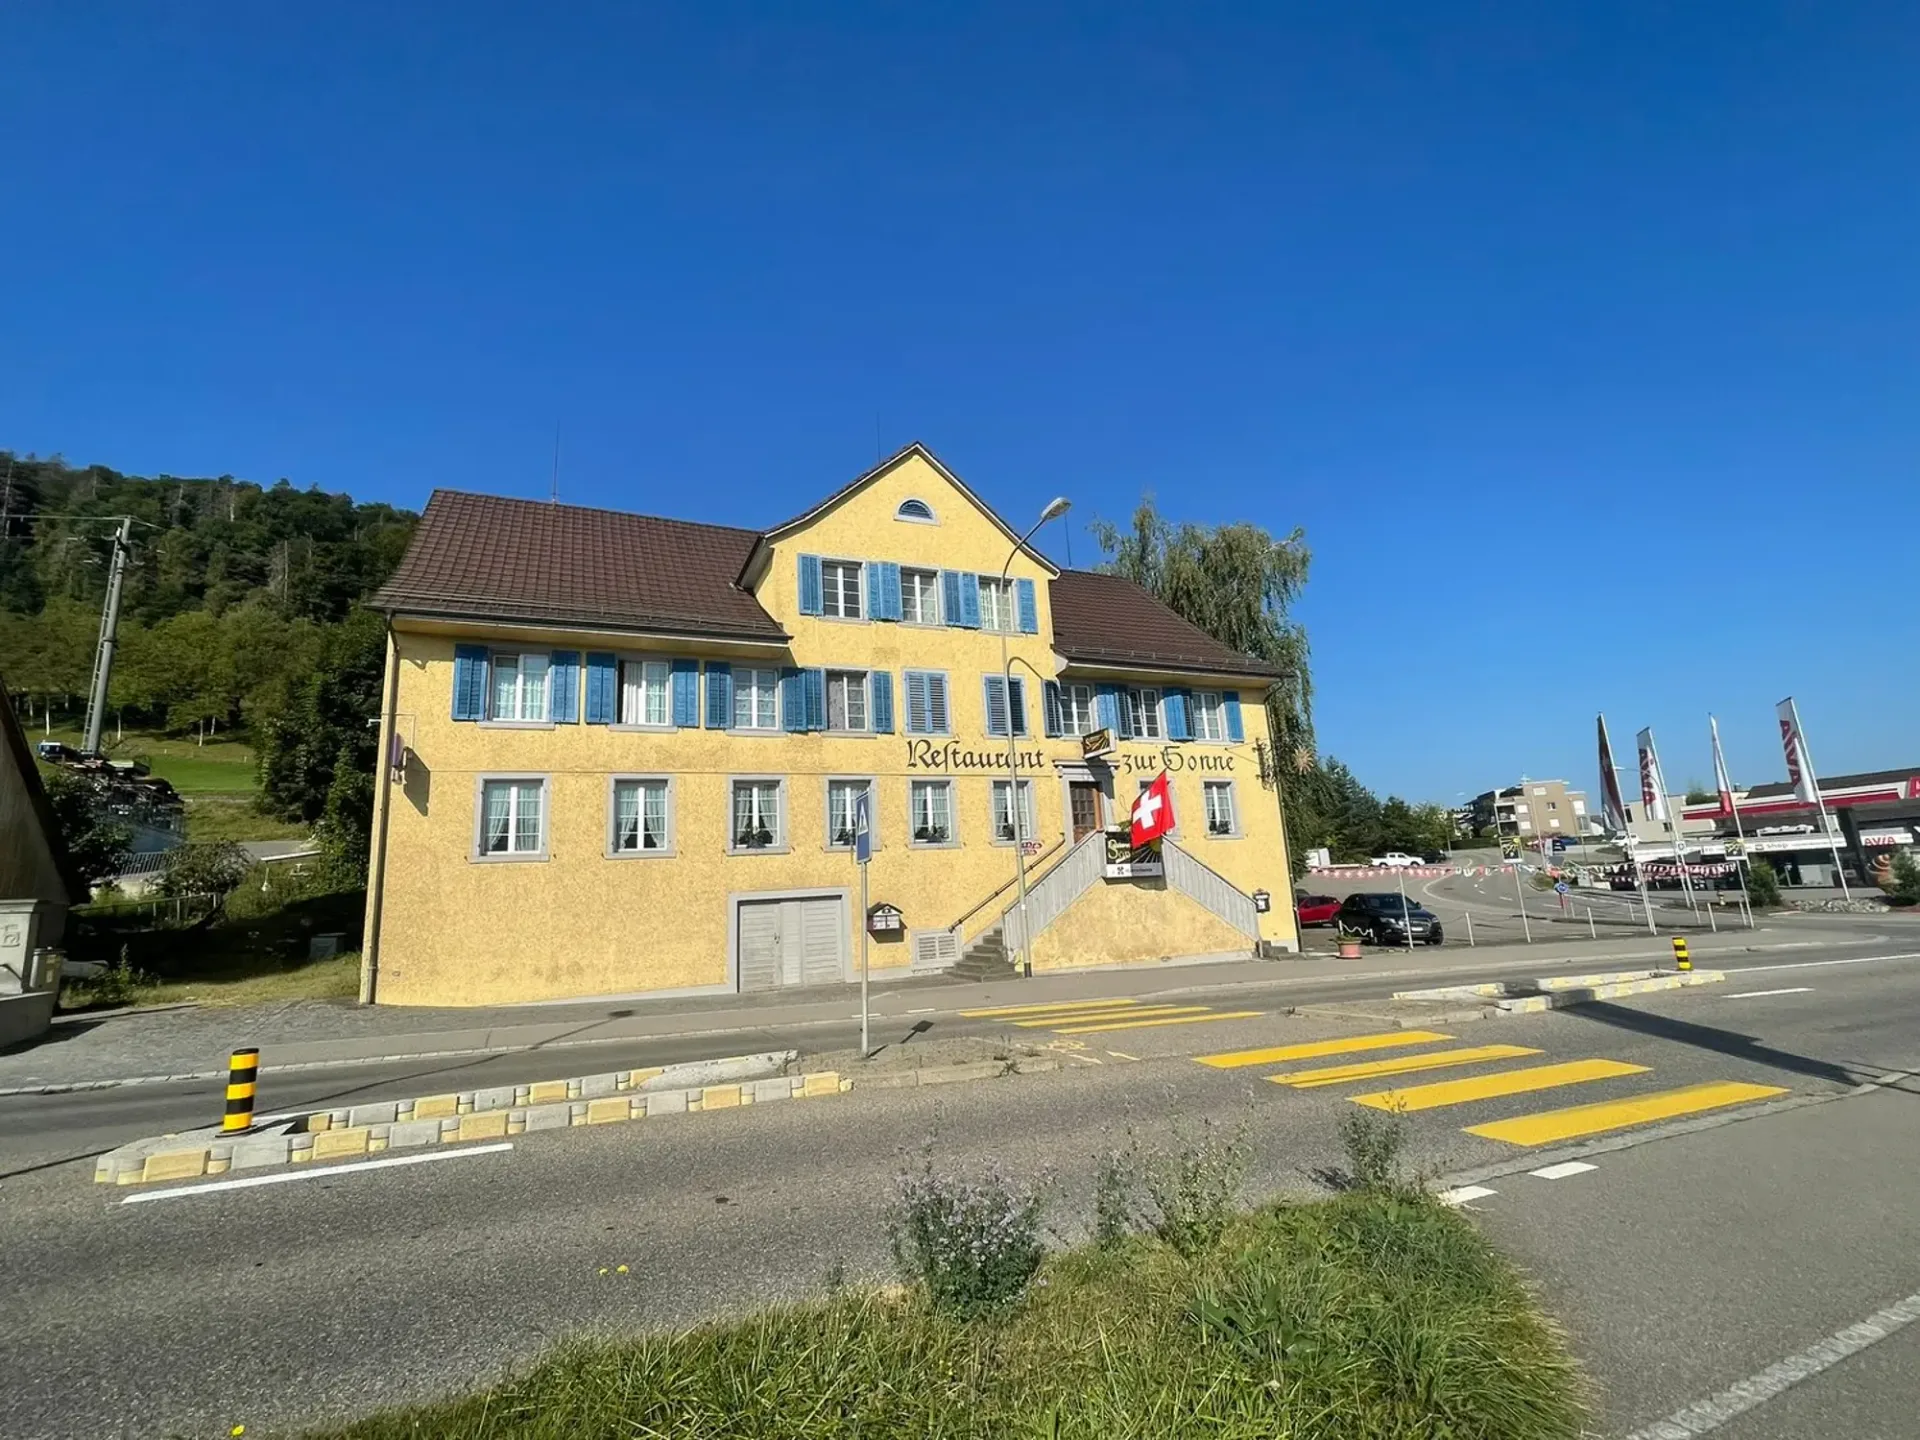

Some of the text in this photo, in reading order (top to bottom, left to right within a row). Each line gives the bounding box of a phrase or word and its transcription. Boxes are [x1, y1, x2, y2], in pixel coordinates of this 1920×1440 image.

[1121, 754, 1157, 775] zur
[1160, 745, 1235, 772] Sonne
[1864, 836, 1897, 847] AVIA
